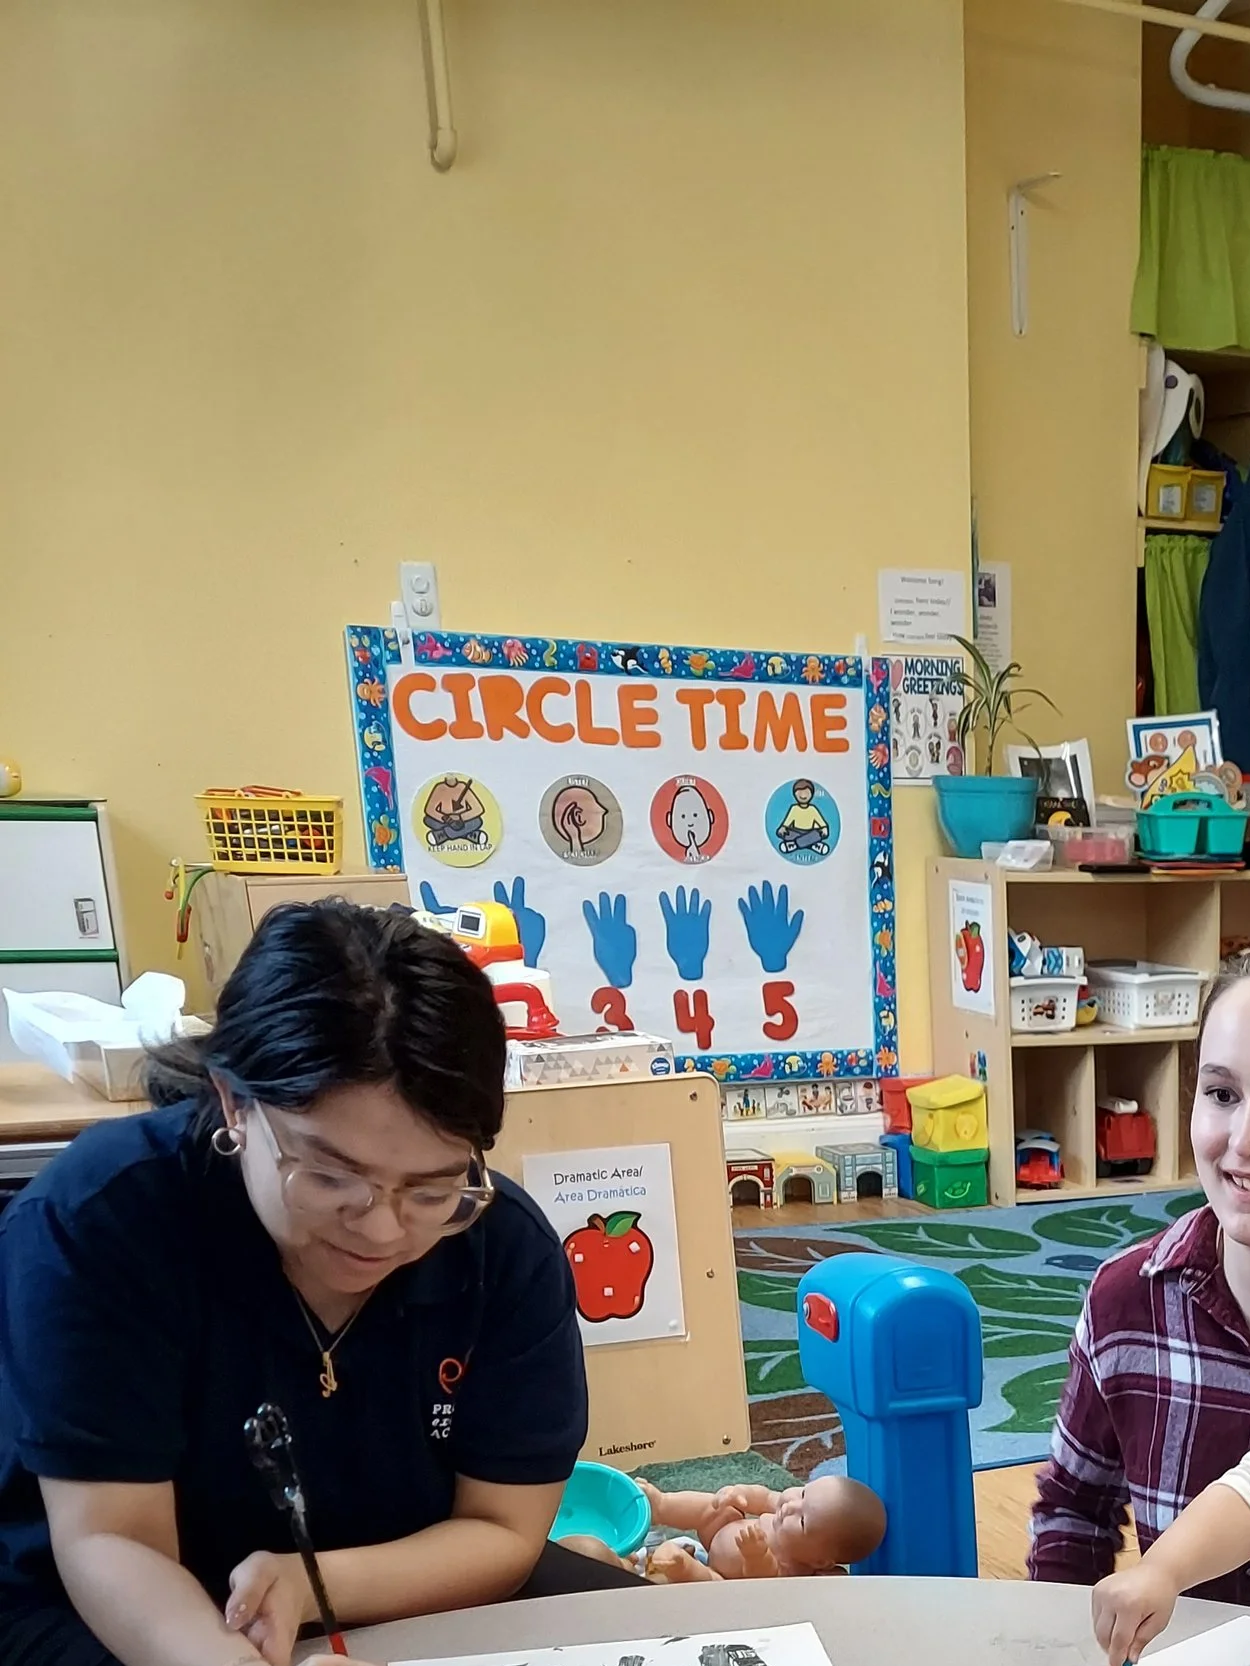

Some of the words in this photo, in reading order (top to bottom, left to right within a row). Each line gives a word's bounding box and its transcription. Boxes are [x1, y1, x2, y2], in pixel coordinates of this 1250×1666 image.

[903, 657, 961, 677] MORNING
[392, 672, 662, 749] CIRCLE
[675, 688, 851, 754] TIME
[427, 845, 446, 853] KEEP
[446, 843, 469, 852] HAND
[469, 843, 478, 852] IN
[480, 842, 494, 851] LAP
[590, 986, 635, 1033] 3
[673, 988, 716, 1051] 4
[761, 980, 799, 1042] 5
[553, 1168, 609, 1186] Dramatic
[610, 1164, 644, 1180] Area/
[598, 1440, 657, 1457] Lakeshore
